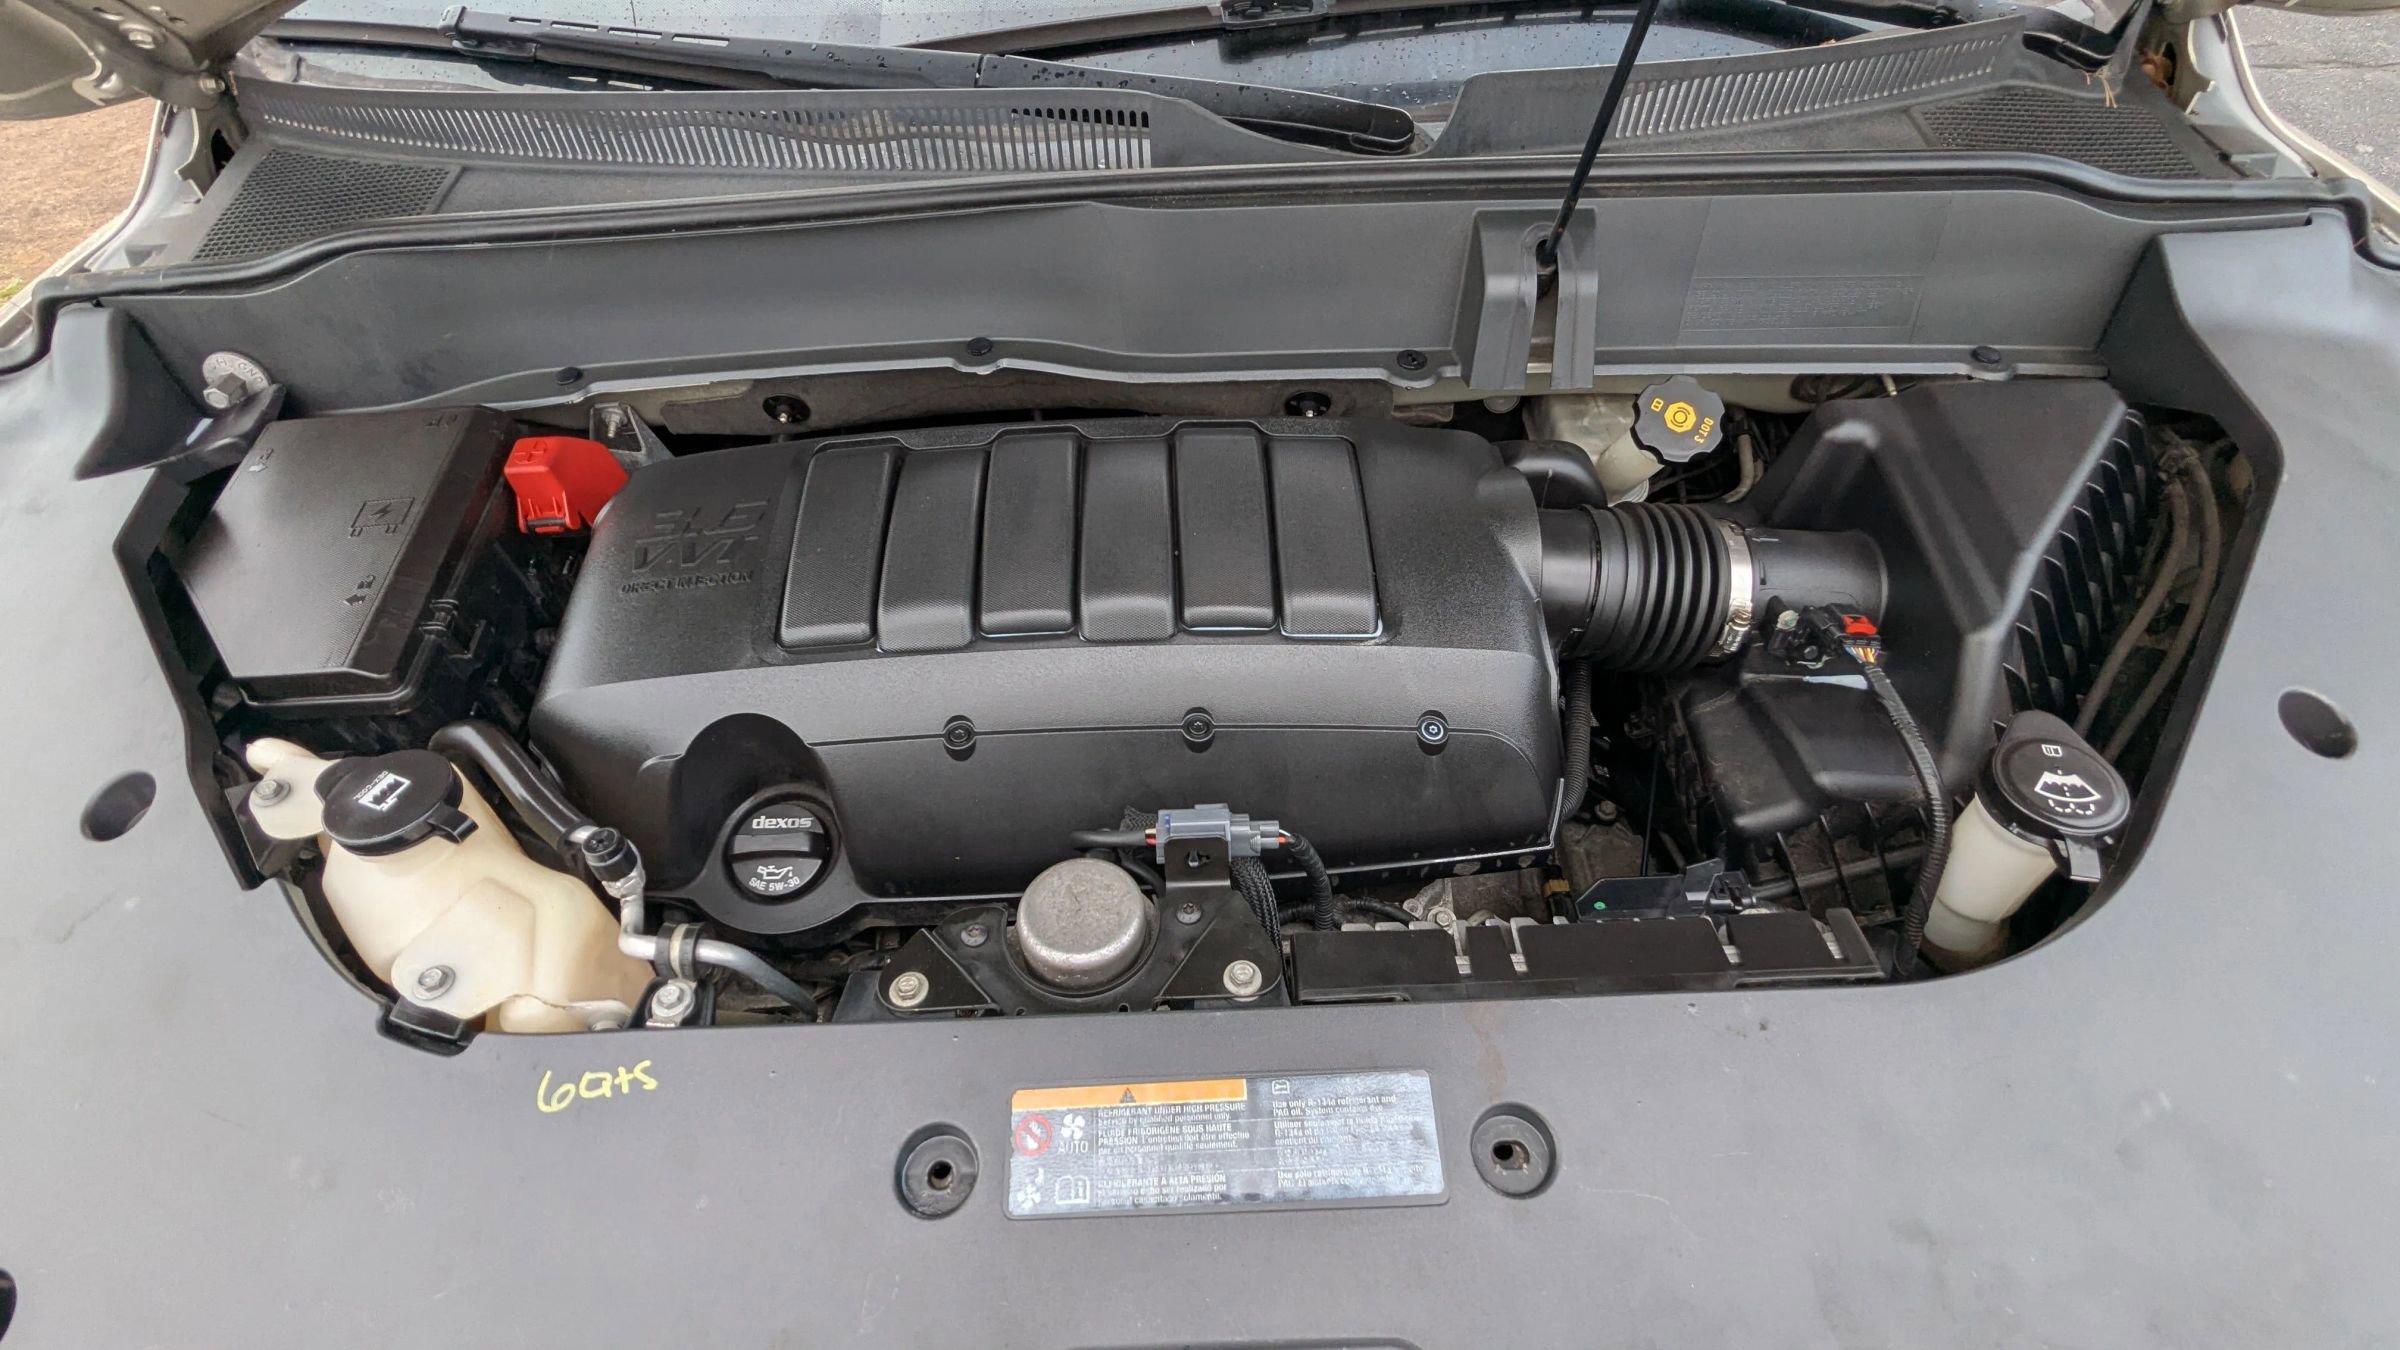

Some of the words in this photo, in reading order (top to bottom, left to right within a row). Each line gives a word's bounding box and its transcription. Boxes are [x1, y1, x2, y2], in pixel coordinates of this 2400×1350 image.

[1698, 417, 1714, 438] DOT
[1694, 435, 1705, 444] 3
[621, 577, 672, 594] DIRECT
[674, 570, 755, 590] INJECTION
[751, 815, 814, 829] dexos
[748, 878, 766, 891] SAE
[768, 876, 800, 892] 5W-30
[1338, 1096, 1379, 1105] refrerant
[1183, 1104, 1204, 1113] HIGH
[1204, 1103, 1246, 1112] PRESSURE
[1182, 1124, 1204, 1133] SOUS
[1206, 1123, 1232, 1132] HAUTE
[1058, 1139, 1089, 1154] AUTO
